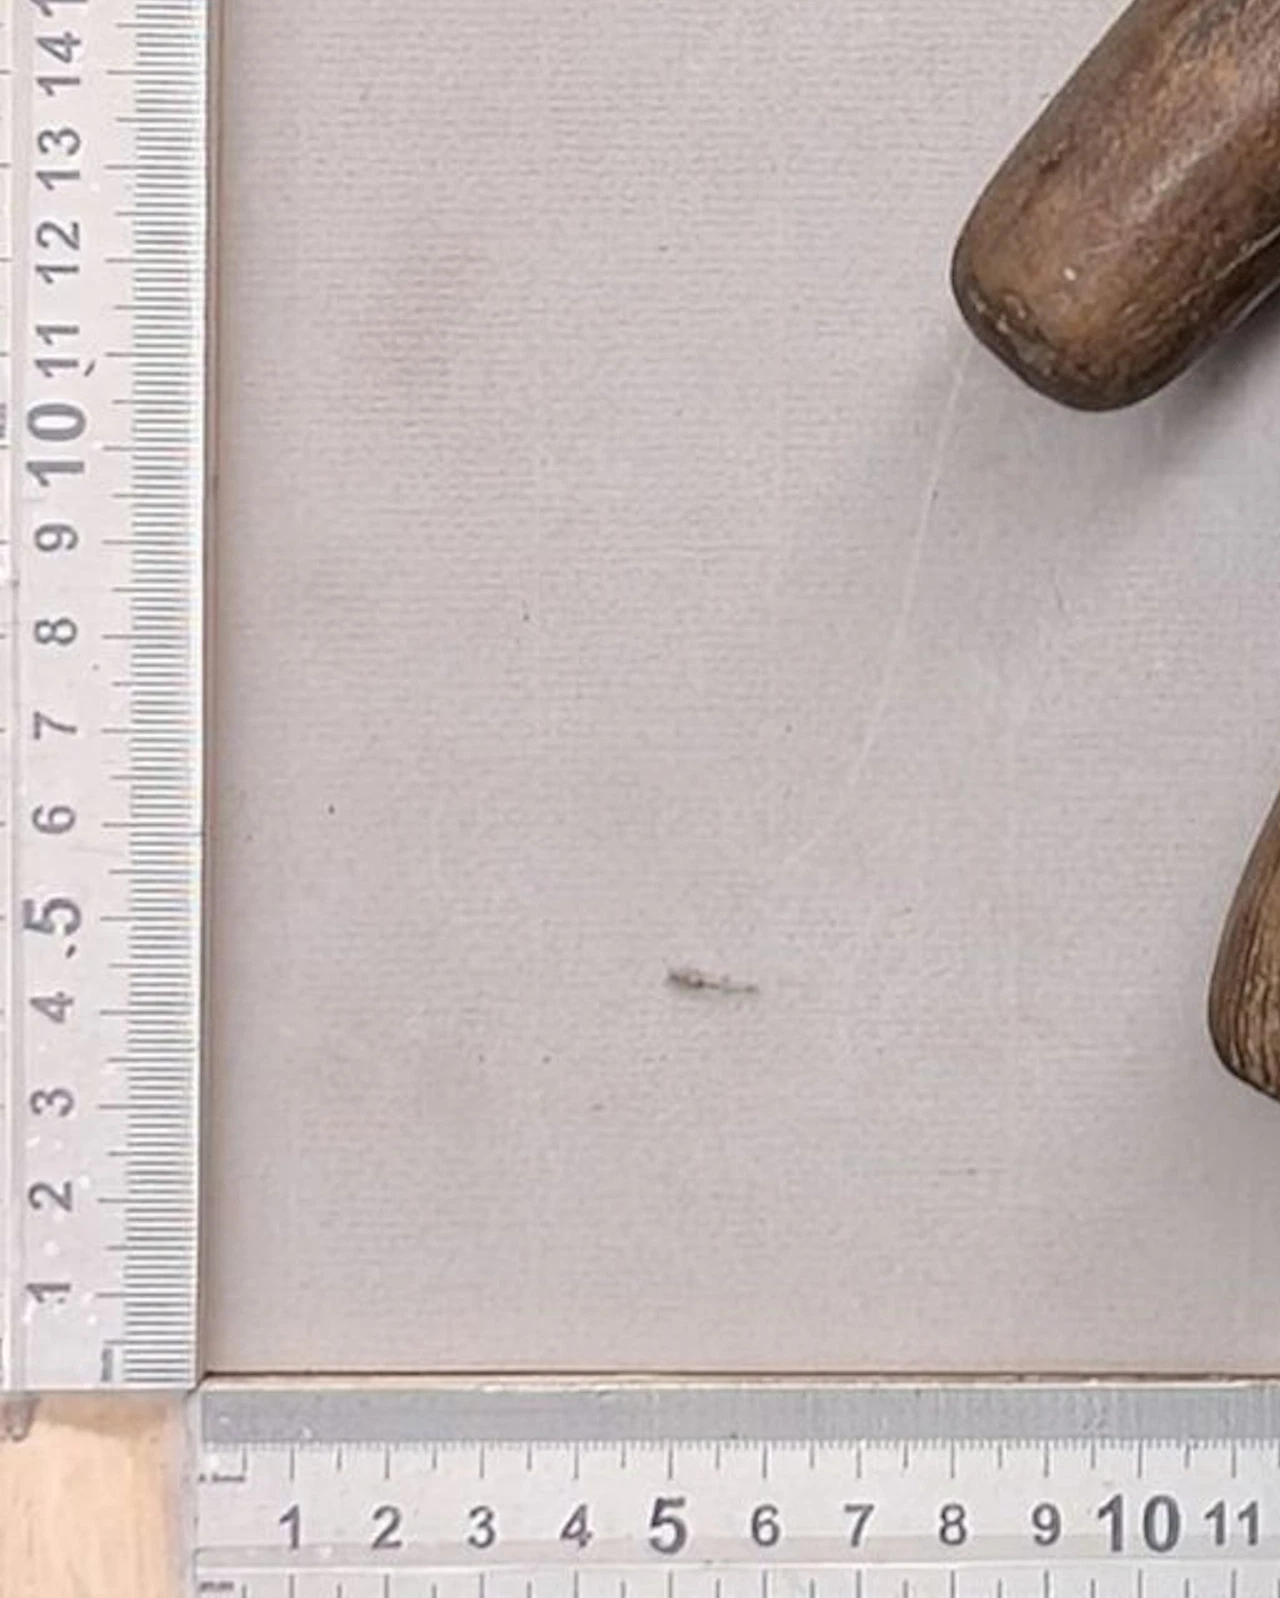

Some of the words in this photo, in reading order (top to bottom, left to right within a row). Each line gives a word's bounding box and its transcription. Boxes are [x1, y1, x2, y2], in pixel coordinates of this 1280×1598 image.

[35, 31, 82, 97] 14
[35, 127, 82, 191] 13
[34, 221, 80, 285] 12
[33, 324, 80, 379] 11
[24, 403, 87, 488] 10
[33, 523, 79, 553] 9
[33, 617, 78, 647] 8
[32, 710, 78, 741] 7
[31, 805, 77, 835] 6
[21, 897, 82, 937] 5
[28, 991, 75, 1025] 4
[28, 1087, 75, 1118] 3
[26, 1181, 73, 1213] 2
[23, 1282, 72, 1304] 1
[279, 1504, 300, 1552] 1
[370, 1505, 403, 1551] 2
[467, 1505, 496, 1550] 3
[559, 1504, 593, 1549] 4
[648, 1496, 687, 1556] 5
[751, 1504, 780, 1548] 6
[844, 1503, 875, 1549] 7
[938, 1503, 968, 1547] 8
[1031, 1502, 1061, 1548] 9
[1097, 1493, 1181, 1554] 10
[1204, 1500, 1259, 1547] 11
